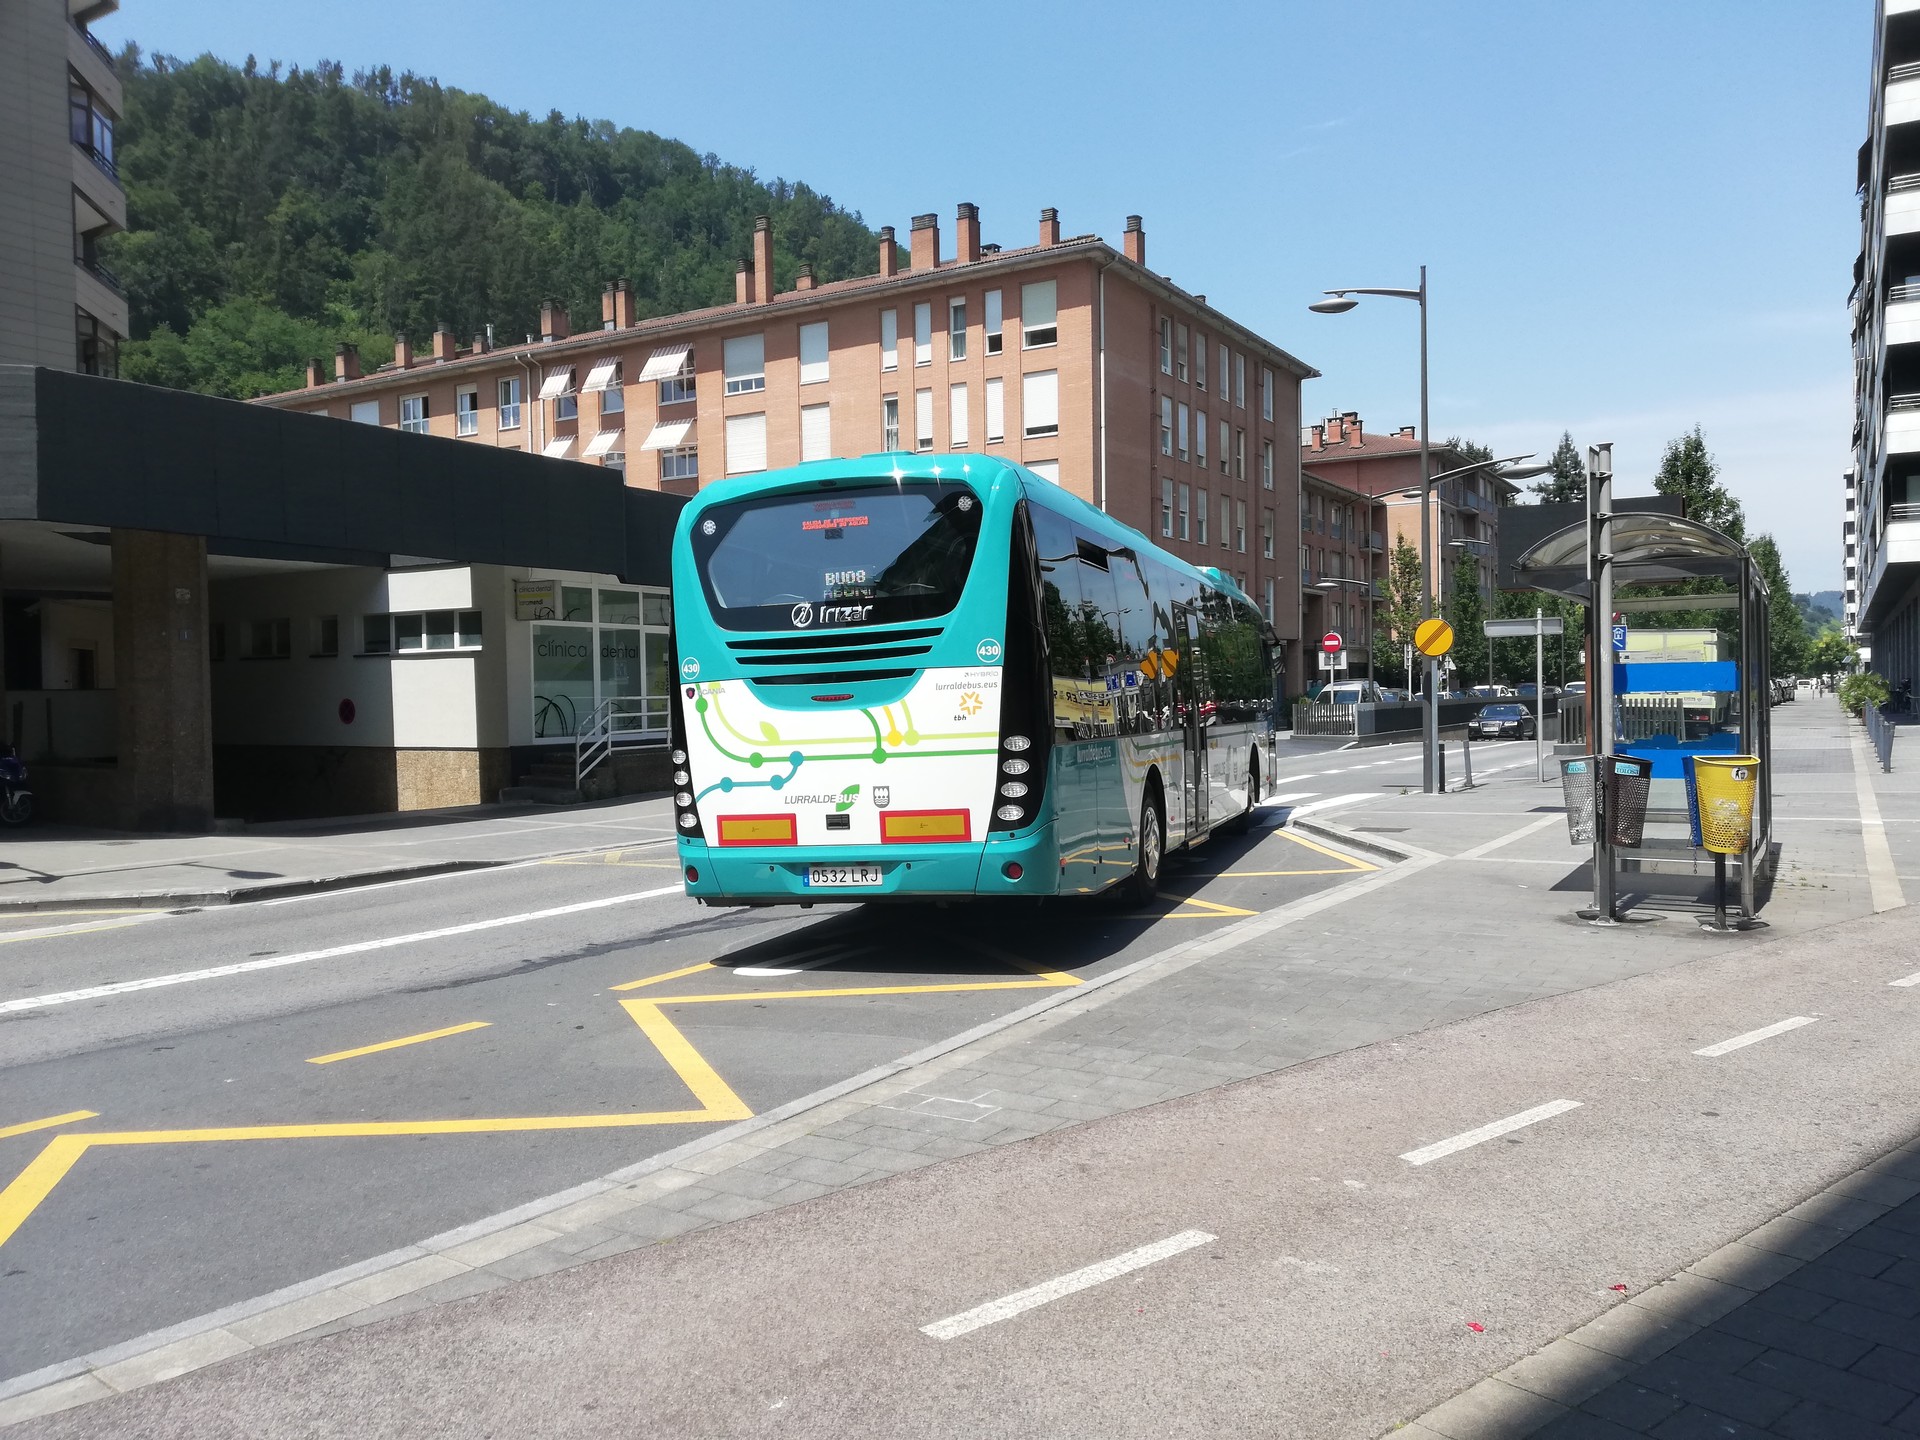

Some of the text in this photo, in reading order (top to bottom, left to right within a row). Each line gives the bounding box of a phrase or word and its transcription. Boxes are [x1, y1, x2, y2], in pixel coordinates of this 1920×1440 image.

[825, 570, 866, 586] BU08
[537, 640, 639, 659] clínica dental
[979, 645, 999, 656] 430
[683, 663, 698, 673] 430
[935, 681, 998, 691] lurraldebus.eus
[812, 869, 847, 883] 0532
[851, 868, 878, 883] LRJ
